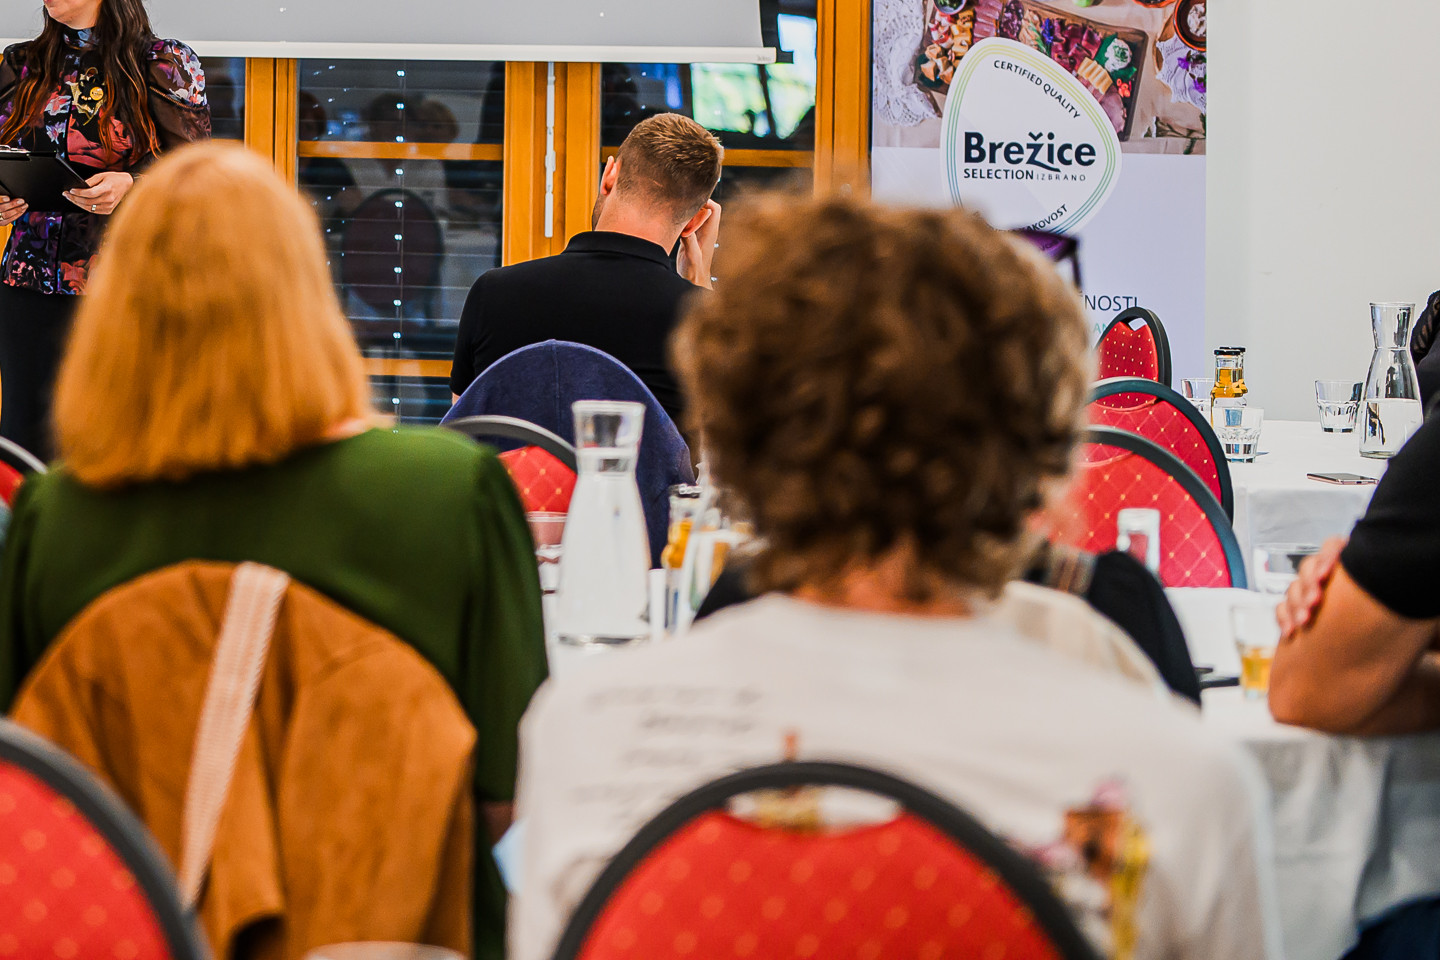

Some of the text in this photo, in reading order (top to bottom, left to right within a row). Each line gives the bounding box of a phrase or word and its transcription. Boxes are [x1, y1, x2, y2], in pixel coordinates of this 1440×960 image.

[993, 59, 1081, 119] CERTIFIED QUALITY
[964, 131, 1097, 173] Brežice
[964, 168, 1034, 180] SELECTION
[1083, 293, 1139, 312] NOSTI
